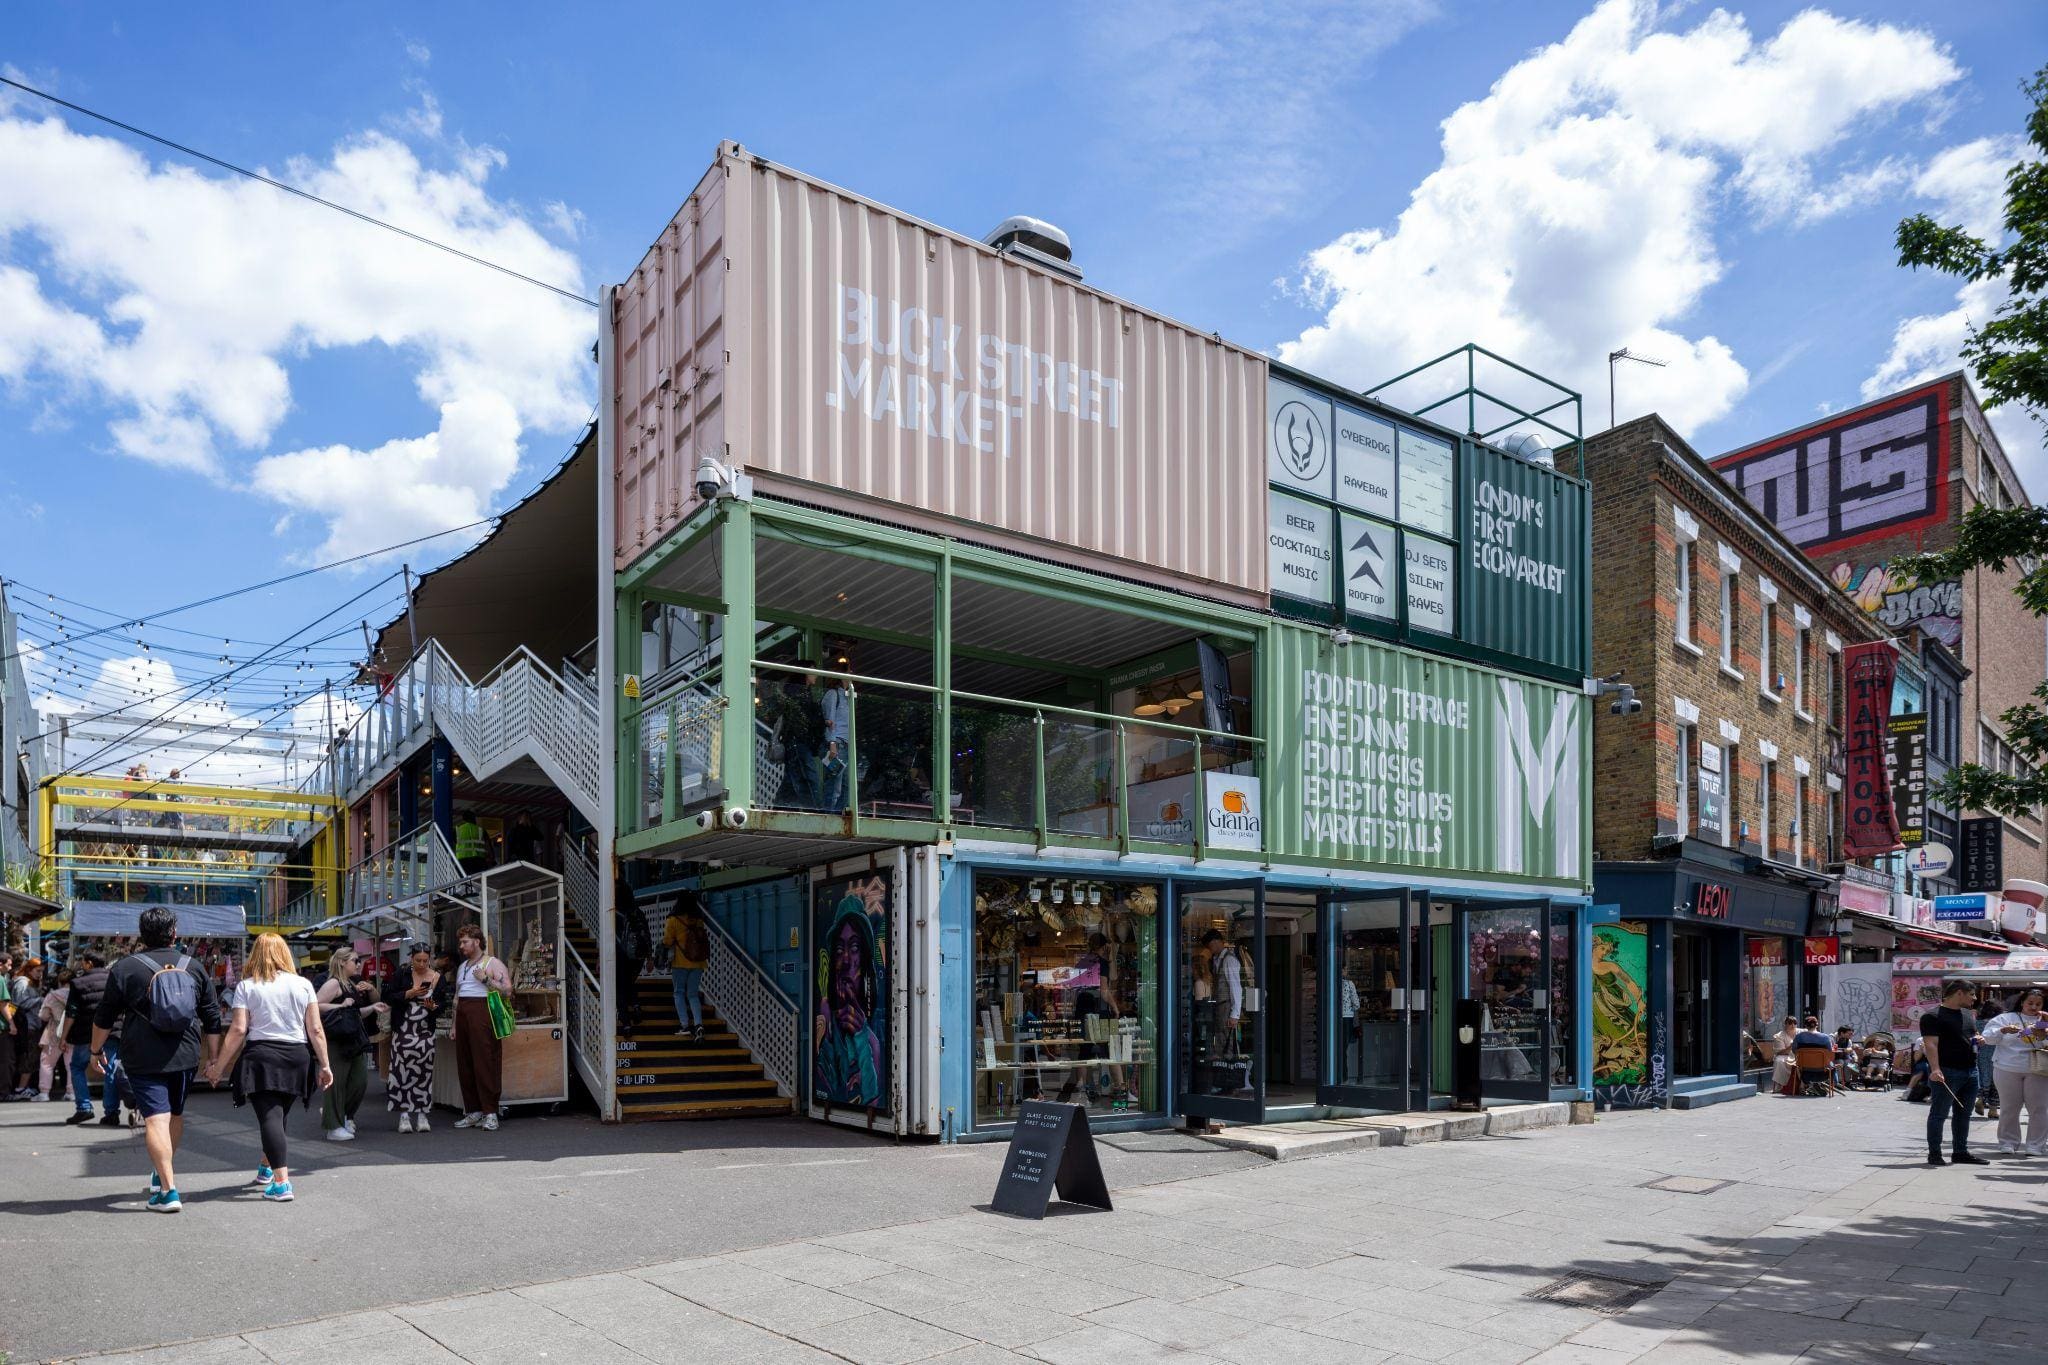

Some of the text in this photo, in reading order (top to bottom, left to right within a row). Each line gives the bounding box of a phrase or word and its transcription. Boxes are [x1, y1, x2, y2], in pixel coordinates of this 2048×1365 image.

[837, 282, 1123, 429] BUCK STREET
[826, 352, 1022, 458] MARKET
[1341, 428, 1390, 454] CYBERDOG
[1344, 475, 1388, 499] RAVEBAR
[1474, 478, 1543, 528] LONDON'S
[1286, 514, 1315, 533] BEER
[1474, 509, 1515, 548] FIRST
[1269, 535, 1331, 561] COCKTAILS
[1283, 563, 1318, 582] MUSIC
[1405, 549, 1448, 572] DJ SETS
[1409, 573, 1444, 592] SILENT
[1348, 589, 1385, 605] ROOFTOP
[1409, 595, 1444, 615] RAVES
[1304, 670, 1468, 729] ROOFTOP TERRACE
[1304, 740, 1424, 786] FOOD KIOSKS
[1854, 679, 1874, 825] TATTOO
[1702, 779, 1719, 795] TO LET
[1907, 734, 1925, 827] PIERCING
[1304, 775, 1452, 822] ECLECTIC SHOPS
[1209, 807, 1260, 832] Grana
[1304, 810, 1442, 854] MARKET STALLS
[1697, 882, 1731, 919] LEON
[1944, 898, 1977, 906] MONEY
[1936, 910, 1985, 918] EXCHANGE
[1806, 955, 1836, 964] LEON
[616, 1042, 637, 1050] LOOR
[616, 1058, 631, 1068] OPS
[634, 1074, 656, 1084] LIFTS
